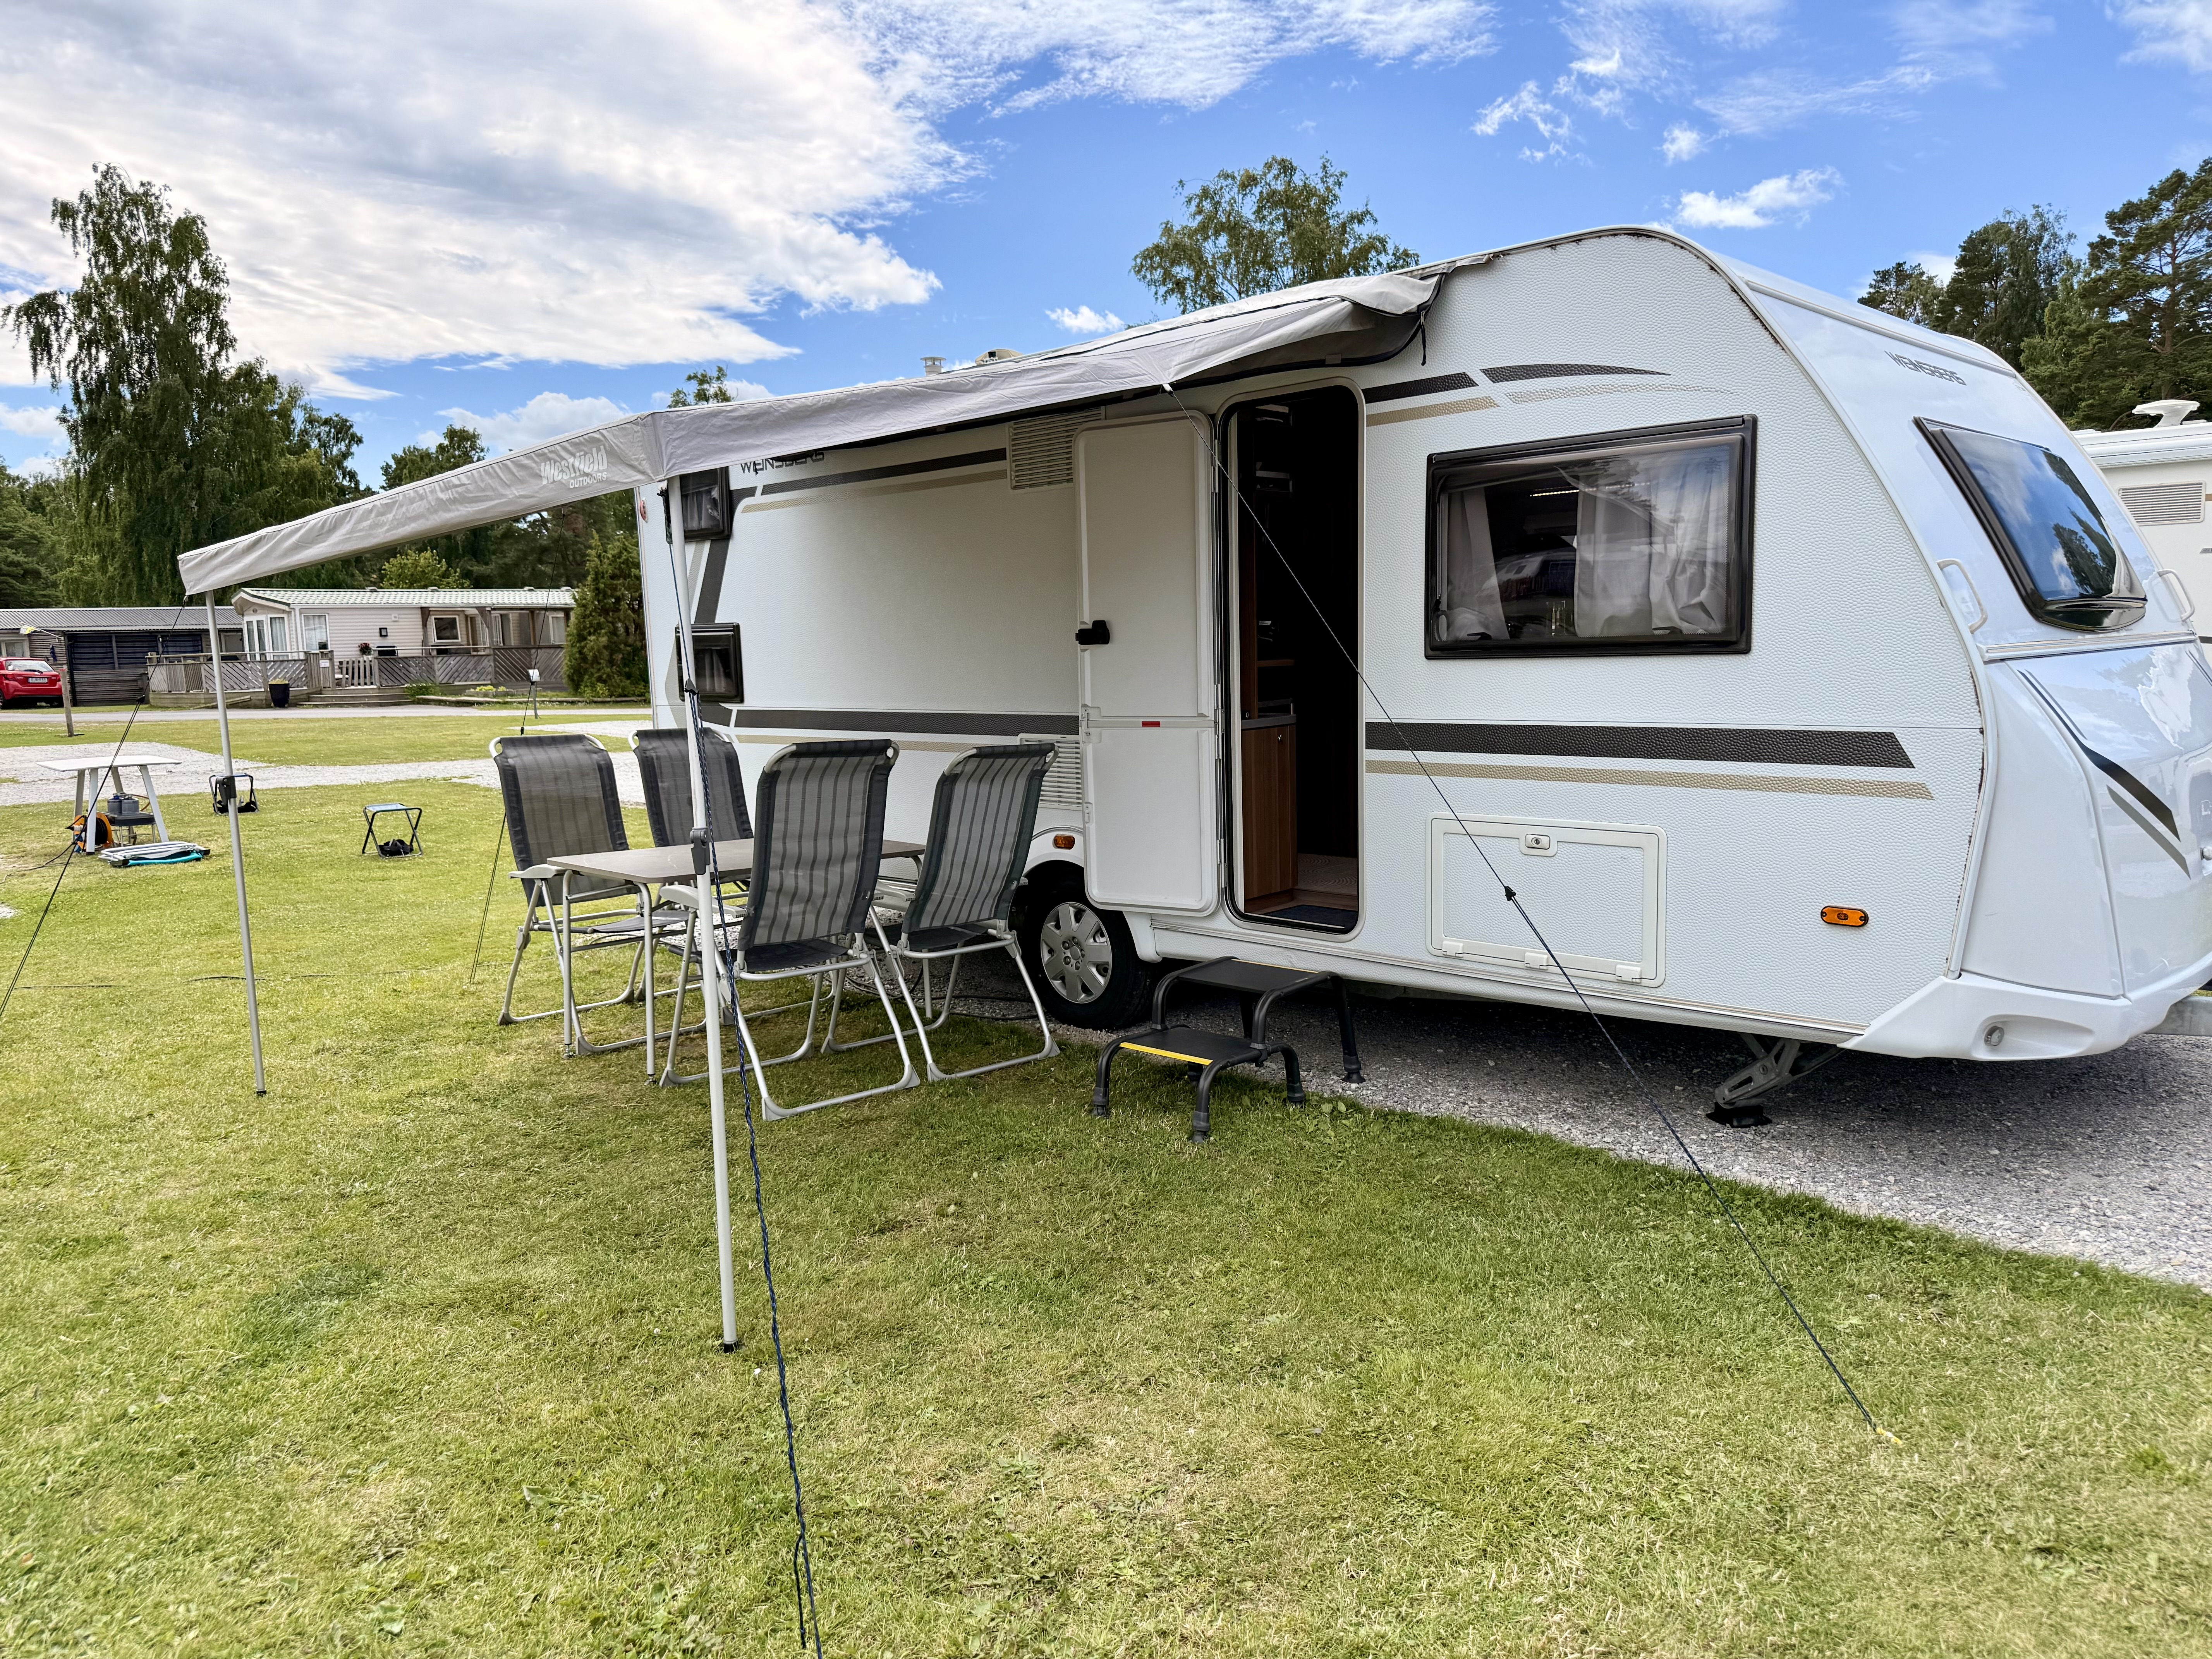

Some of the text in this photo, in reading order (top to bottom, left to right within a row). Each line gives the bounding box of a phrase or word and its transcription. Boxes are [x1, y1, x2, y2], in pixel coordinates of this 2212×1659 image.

[1884, 350, 1967, 386] WEINSBERG
[541, 445, 608, 485] Westfield
[569, 472, 607, 488] OUTDOORS
